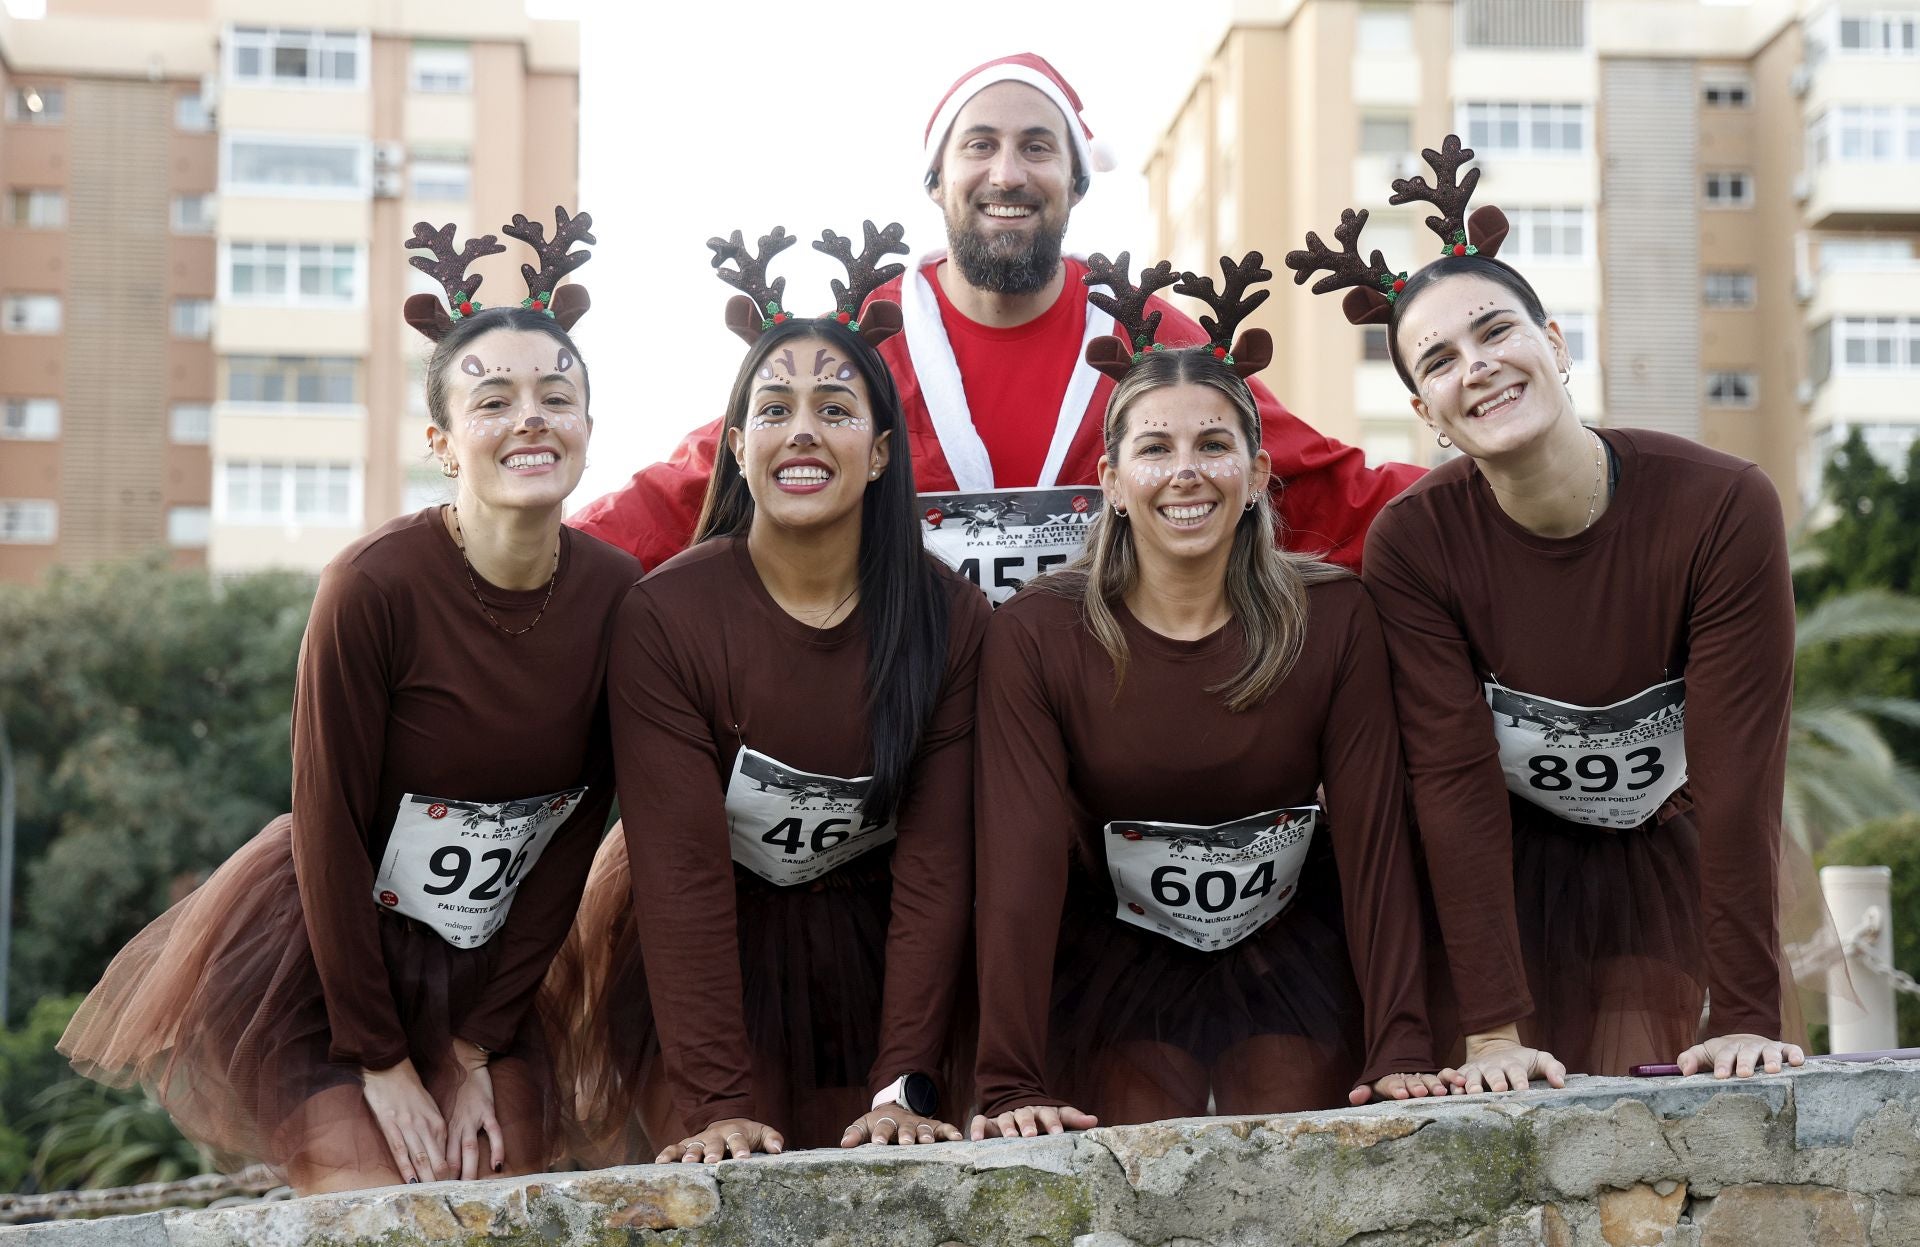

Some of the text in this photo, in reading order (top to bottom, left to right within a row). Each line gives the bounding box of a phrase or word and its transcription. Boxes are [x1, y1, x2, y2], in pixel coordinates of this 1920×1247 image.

[1032, 525, 1088, 533] CARRER
[966, 539, 1018, 547] PALMA
[1529, 747, 1664, 792] 893
[1609, 792, 1646, 803] PORTILLO
[494, 825, 518, 834] SAN
[1251, 814, 1309, 844] XIV
[460, 831, 512, 839] PALMA
[1240, 826, 1306, 853] CARRERA
[781, 856, 815, 865] DANIELA
[1169, 853, 1224, 862] PALMA
[423, 832, 537, 901] 926
[1151, 860, 1277, 913] 604
[437, 902, 488, 914] PAU VICENTE
[1172, 912, 1203, 923] HELENA
[1204, 916, 1232, 924] MUÑOZ
